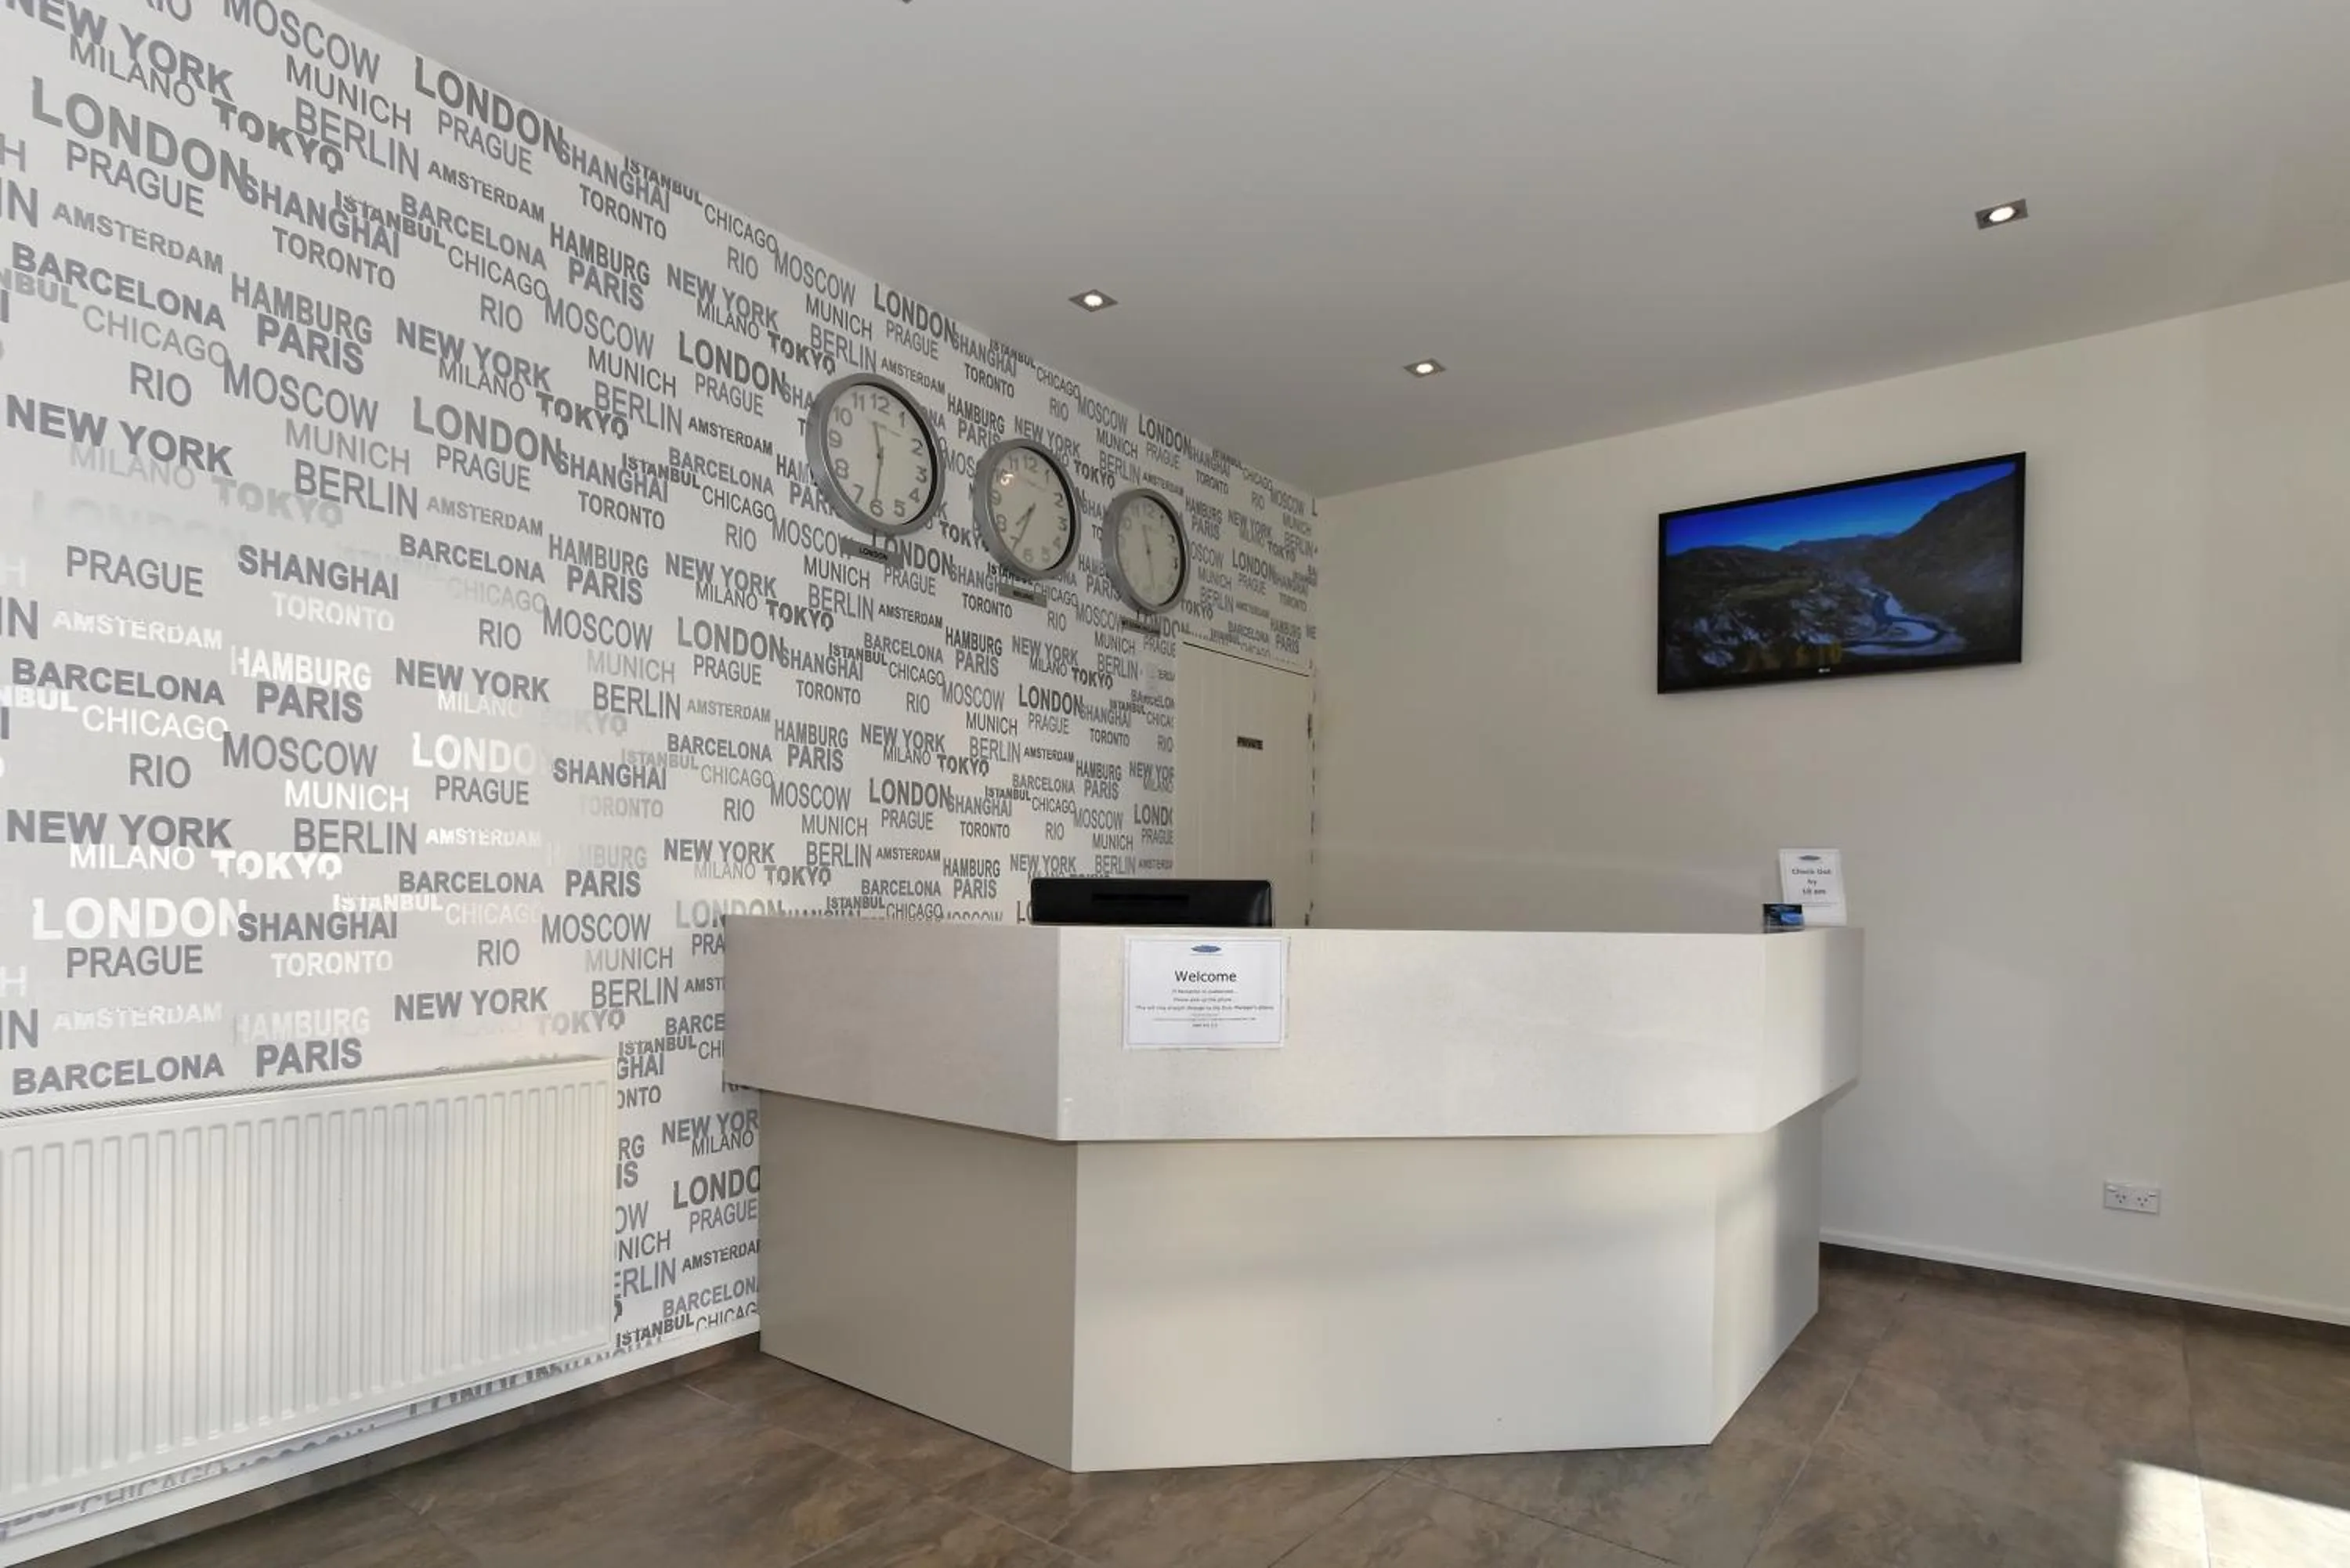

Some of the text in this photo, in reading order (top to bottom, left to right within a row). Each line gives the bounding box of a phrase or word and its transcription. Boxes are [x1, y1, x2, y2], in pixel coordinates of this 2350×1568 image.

[70, 34, 195, 107] MILANO
[120, 24, 233, 102] YORK
[287, 54, 410, 135] MUNICH
[415, 56, 563, 161] LONDON
[32, 75, 249, 199] LONDON
[212, 96, 344, 175] TOKYO
[296, 96, 419, 182] BERLIN
[438, 109, 532, 176] PRAGUE
[67, 139, 204, 218] PRAGUE
[428, 161, 544, 224] AMSTERDAM
[556, 137, 670, 214] SHANGHAI
[239, 171, 400, 258] SHANGHAI
[335, 190, 446, 248] ISTANBUL
[579, 183, 667, 240] TORONTO
[704, 204, 778, 256] CHICAGO
[51, 203, 222, 274] AMSTERDAM
[401, 192, 547, 272] BARCELONA
[273, 226, 396, 290] TORONTO
[448, 245, 549, 304] CHICAGO
[551, 222, 650, 287] HAMBURG
[727, 246, 759, 280] RIO
[13, 242, 226, 331] BARCELONA
[569, 256, 645, 312] PARIS
[774, 246, 855, 308] MOSCOW
[231, 272, 372, 345] HAMBURG
[667, 264, 779, 333] NEW YORK
[806, 293, 872, 341] MUNICH
[873, 282, 956, 347] LONDON
[82, 305, 230, 370] CHICAGO
[257, 313, 365, 375] PARIS
[544, 292, 654, 361] MOSCOW
[397, 317, 551, 392] NEW YORK
[679, 330, 786, 400] LONDON
[768, 330, 837, 376] TOKYO
[811, 323, 877, 372] BERLIN
[130, 362, 192, 407] RIO
[588, 345, 676, 399] MUNICH
[880, 358, 945, 396] AMSTERDAM
[223, 357, 378, 433] MOSCOW
[595, 380, 682, 436] BERLIN
[696, 371, 764, 417] PRAGUE
[852, 392, 865, 411] 11
[870, 393, 890, 414] 12
[948, 392, 1005, 435] HAMBURG
[414, 395, 562, 471] LONDON
[536, 390, 629, 441] TOKYO
[833, 405, 852, 426] 10
[900, 411, 905, 427] 1
[7, 395, 233, 477] NEW YORK
[688, 416, 772, 456] AMSTERDAM
[829, 429, 842, 447] 9
[911, 438, 924, 456] 2
[437, 443, 530, 493] PRAGUE
[555, 448, 668, 503] SHANGHAI
[622, 452, 701, 490] ISTANBUL
[669, 446, 774, 497] BARCELONA
[835, 458, 849, 479] 8
[916, 466, 927, 483] 3
[295, 458, 418, 520] BERLIN
[702, 485, 776, 524] CHICAGO
[853, 483, 864, 504] 7
[870, 499, 884, 517] 6
[894, 500, 905, 517] 5
[909, 488, 920, 503] 4
[577, 490, 665, 530] TORONTO
[67, 545, 204, 598] PRAGUE
[239, 544, 399, 600] SHANGHAI
[400, 533, 545, 583] BARCELONA
[549, 533, 648, 579] HAMBURG
[665, 552, 777, 599] NEW YORK
[804, 555, 870, 590] MUNICH
[567, 564, 643, 605] PARIS
[808, 583, 874, 622] BERLIN
[765, 598, 834, 633] TOKYO
[878, 603, 942, 629] AMSTERDAM
[962, 591, 1012, 619] TORONTO
[479, 618, 522, 651] RIO
[543, 605, 653, 652] MOSCOW
[677, 616, 785, 665] LONDON
[945, 626, 1003, 657] HAMBURG
[13, 657, 226, 706] BARCELONA
[396, 657, 550, 703] NEW YORK
[693, 653, 761, 686] PRAGUE
[257, 680, 364, 724] PARIS
[593, 681, 680, 721] BERLIN
[796, 678, 861, 705] TORONTO
[1018, 683, 1083, 717] LONDON
[83, 705, 229, 743] CHICAGO
[775, 718, 848, 749] HAMBURG
[861, 723, 945, 753] NEW YORK
[223, 731, 378, 778] MOSCOW
[667, 733, 772, 763] BARCELONA
[787, 742, 844, 772] PARIS
[130, 753, 191, 789] RIO
[436, 775, 529, 806] PRAGUE
[553, 757, 666, 790] SHANGHAI
[285, 779, 408, 813] MUNICH
[723, 797, 754, 822] RIO
[770, 780, 851, 811] MOSCOW
[870, 777, 952, 810] LONDON
[7, 810, 233, 849] NEW YORK
[295, 817, 417, 855] BERLIN
[881, 807, 934, 831] PRAGUE
[70, 844, 194, 871] MILANO
[211, 850, 342, 881] TOKYO
[663, 838, 775, 865] NEW YORK
[806, 841, 872, 868] BERLIN
[876, 847, 941, 862] AMSTERDAM
[943, 857, 1000, 878] HAMBURG
[400, 871, 544, 894] BARCELONA
[565, 869, 641, 898] PARIS
[862, 879, 942, 896] BARCELONA
[33, 898, 248, 940] LONDON
[238, 912, 397, 941] SHANGHAI
[541, 913, 651, 944] MOSCOW
[67, 945, 203, 978] PRAGUE
[478, 939, 520, 967] RIO
[591, 976, 678, 1010] BERLIN
[1174, 970, 1237, 982] Welcome
[395, 987, 548, 1022] NEW YORK
[13, 1053, 225, 1096] BARCELONA
[256, 1037, 363, 1077] PARIS
[661, 1115, 710, 1146] NEW
[692, 1130, 754, 1157] MILANO
[689, 1198, 757, 1234] PRAGUE
[616, 1313, 695, 1349] ISTANBUL
